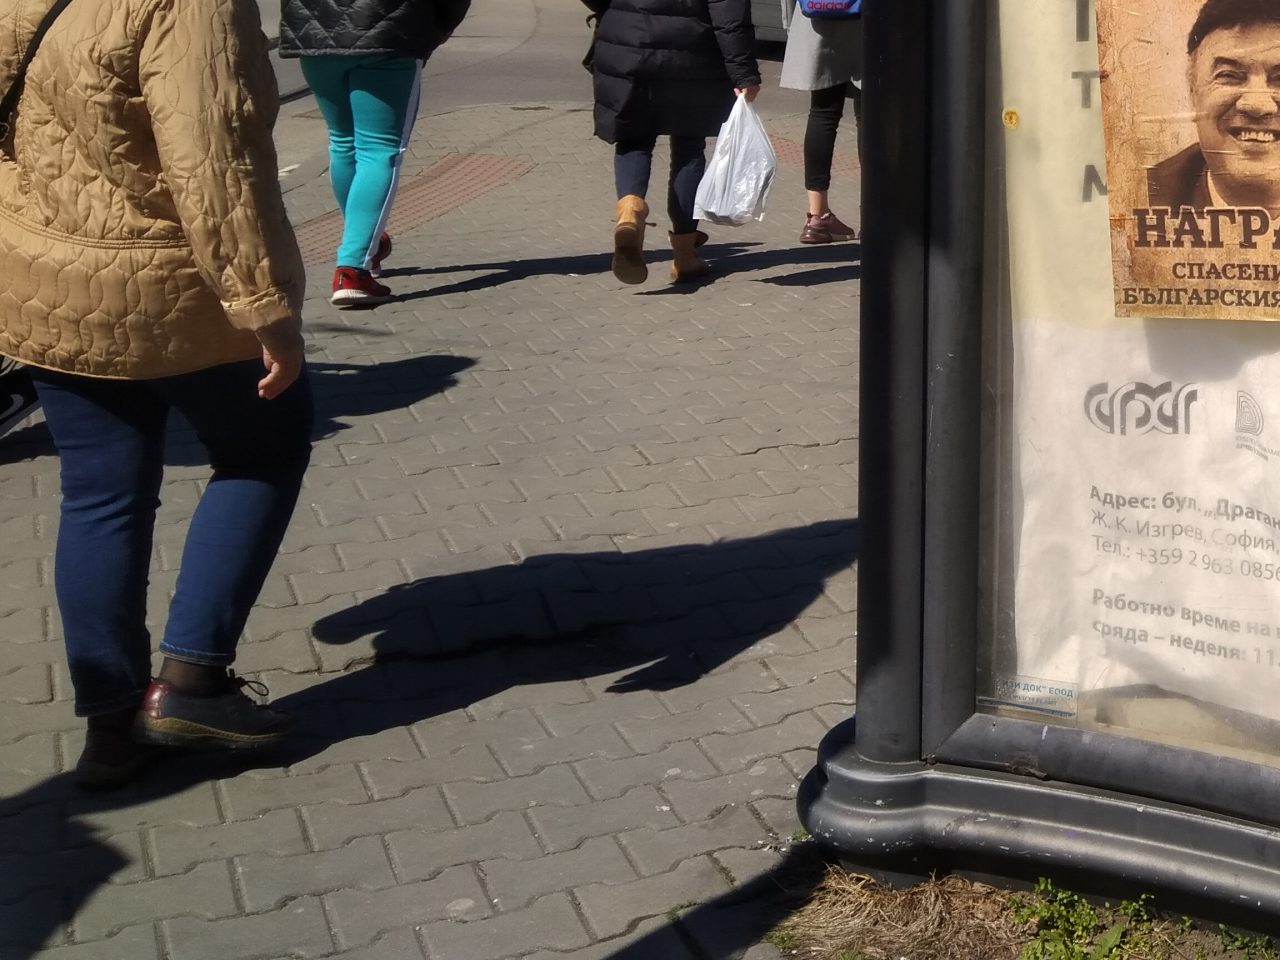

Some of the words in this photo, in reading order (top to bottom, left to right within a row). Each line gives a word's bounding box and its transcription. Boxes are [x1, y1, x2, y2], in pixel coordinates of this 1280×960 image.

[1090, 485, 1157, 510] Адрес:
[1091, 588, 1176, 618] Работно
[1180, 605, 1241, 634] време
[1092, 619, 1149, 646] сряда
